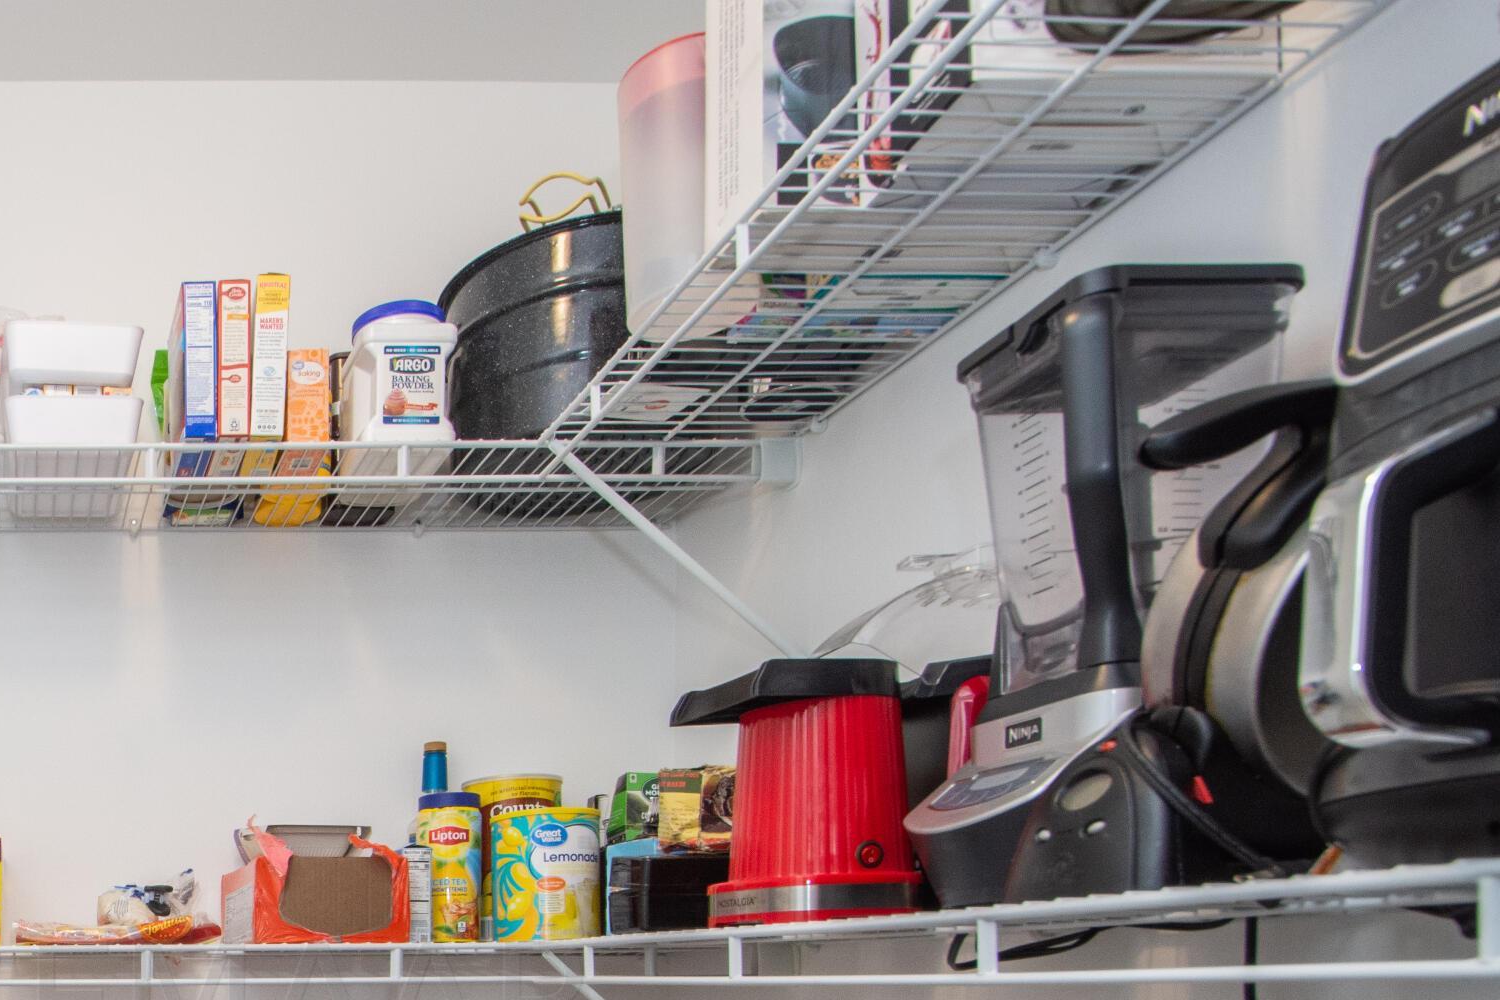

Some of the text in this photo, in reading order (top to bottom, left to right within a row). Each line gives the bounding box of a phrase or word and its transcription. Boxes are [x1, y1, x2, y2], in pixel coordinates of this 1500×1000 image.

[394, 358, 431, 372] ARGO
[391, 375, 431, 383] BAKING
[391, 382, 435, 390] POWDER
[1009, 725, 1039, 744] NINJA
[431, 831, 467, 842] Lipton
[534, 828, 562, 838] Great
[451, 878, 467, 886] TEA
